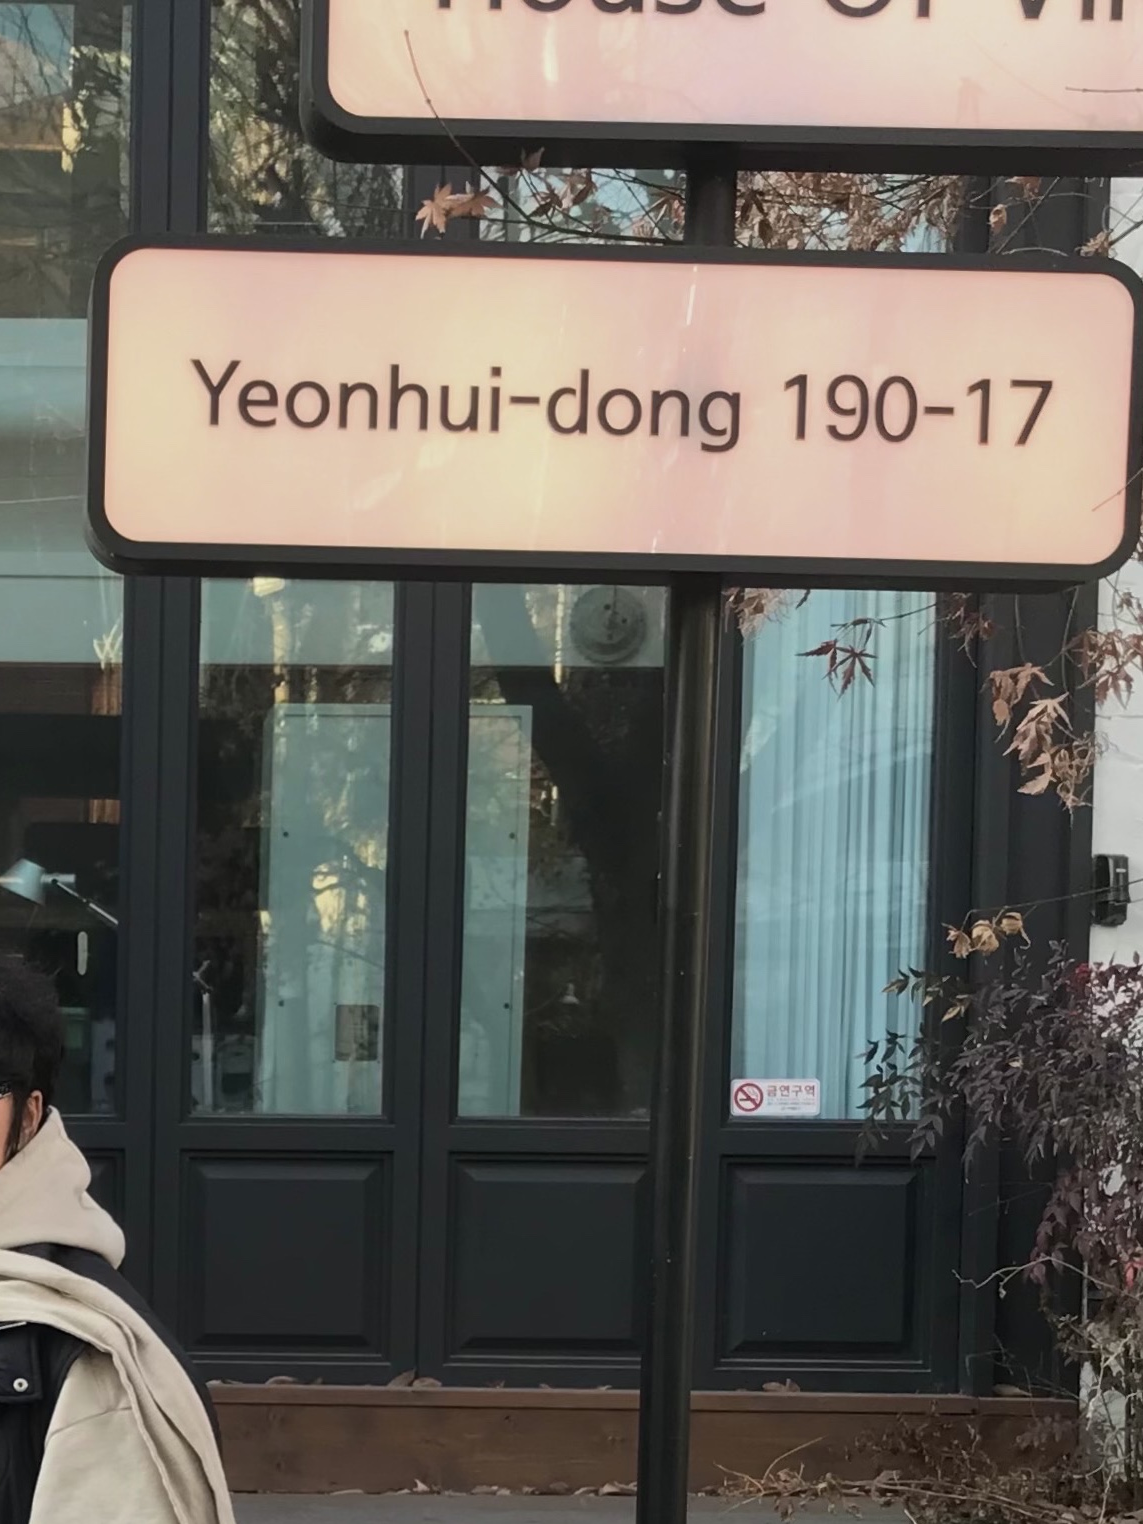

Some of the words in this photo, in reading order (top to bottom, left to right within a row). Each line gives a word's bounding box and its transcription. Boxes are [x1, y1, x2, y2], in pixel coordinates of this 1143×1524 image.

[191, 359, 742, 455] Yeonhui-dong
[784, 373, 1054, 447] 190-17
[767, 1084, 816, 1098] 금연구역
